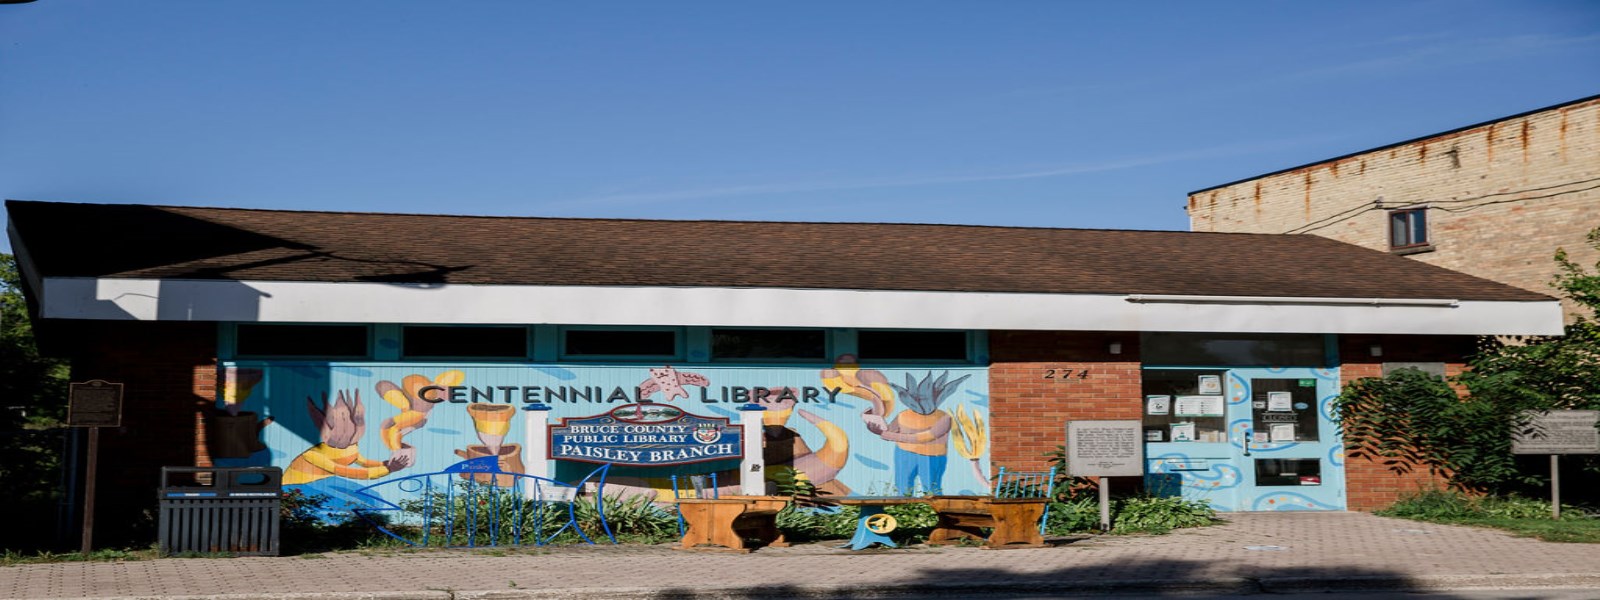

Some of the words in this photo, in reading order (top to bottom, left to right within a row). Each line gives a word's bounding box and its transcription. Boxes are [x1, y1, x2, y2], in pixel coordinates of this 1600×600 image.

[1044, 369, 1089, 379] 274
[418, 385, 654, 403] CENTENNIAL
[700, 385, 842, 403] LIBRARY
[570, 425, 619, 433] BRUCE
[625, 425, 687, 433] COUNTY
[563, 435, 618, 443] PUBLIC
[623, 435, 687, 443] LIBRARY
[560, 444, 642, 461] PAISLEY
[649, 443, 733, 461] BRANCH
